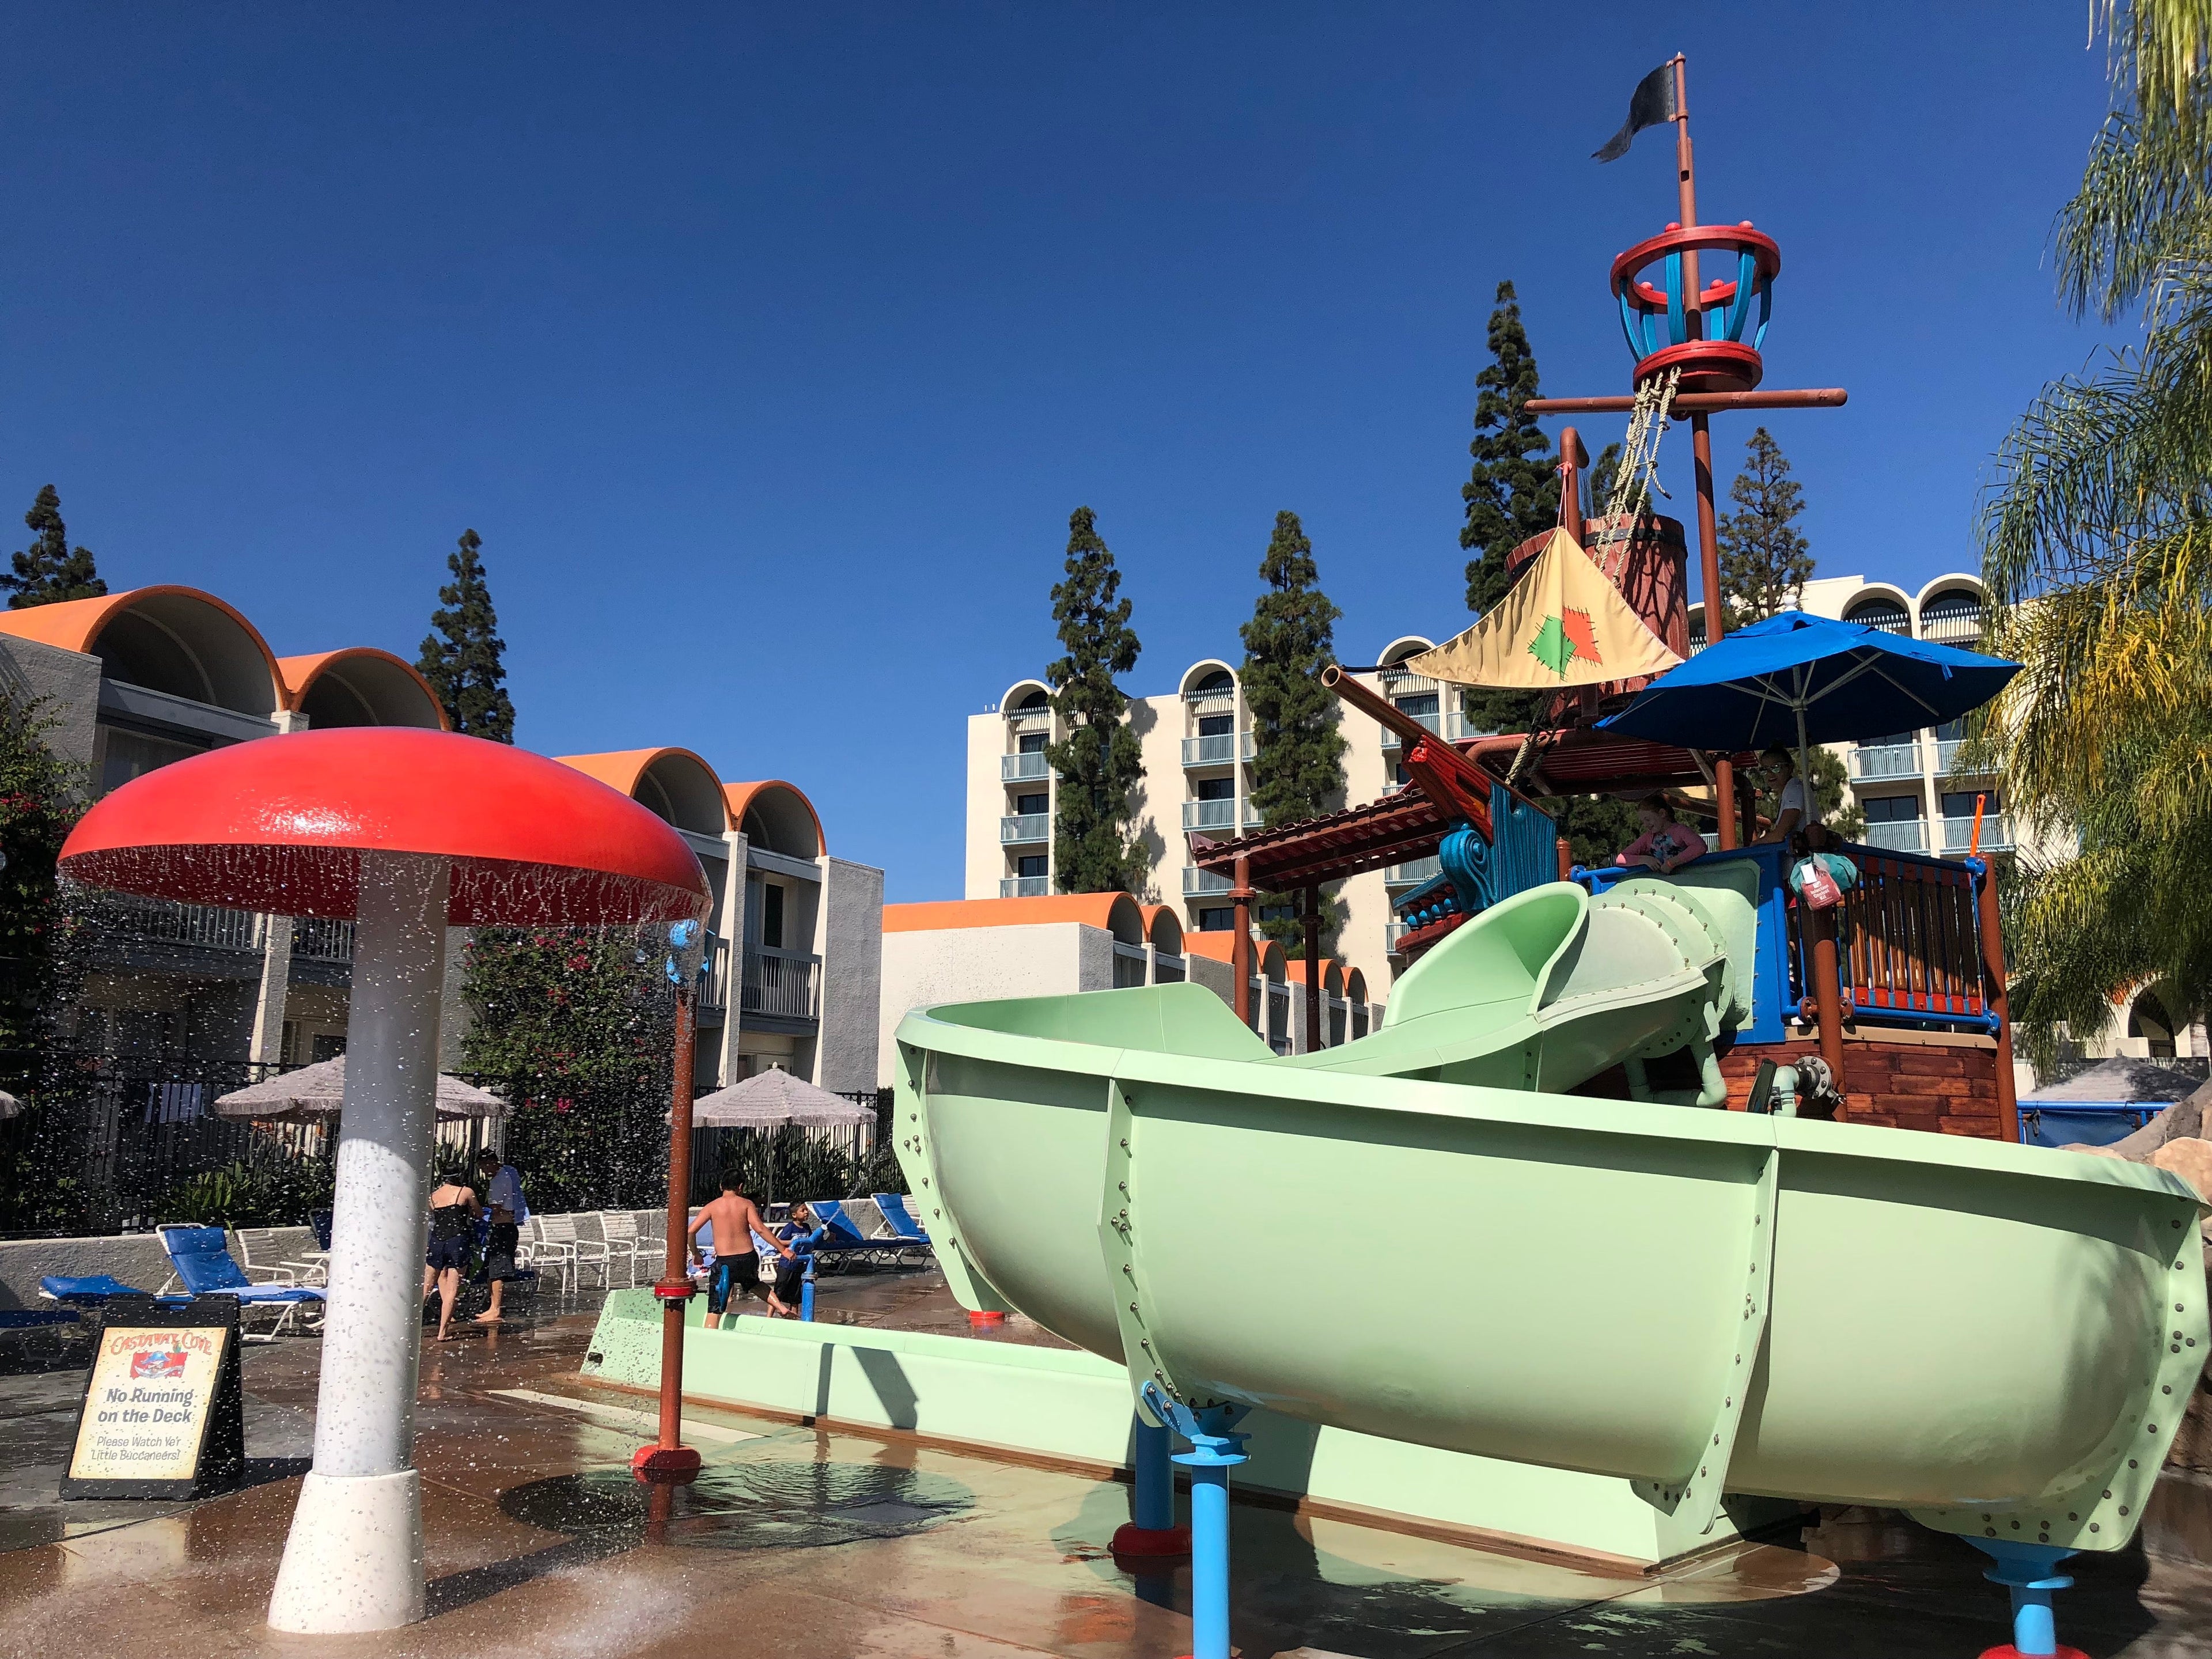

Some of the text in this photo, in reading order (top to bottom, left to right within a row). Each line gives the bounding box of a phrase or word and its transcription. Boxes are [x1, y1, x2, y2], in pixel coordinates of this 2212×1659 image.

[106, 1388, 194, 1407] No Running
[97, 1408, 192, 1423] on the Deck
[97, 1436, 129, 1446] Please
[132, 1436, 162, 1446] Watch
[92, 1449, 181, 1461] Little Buccaneers!
